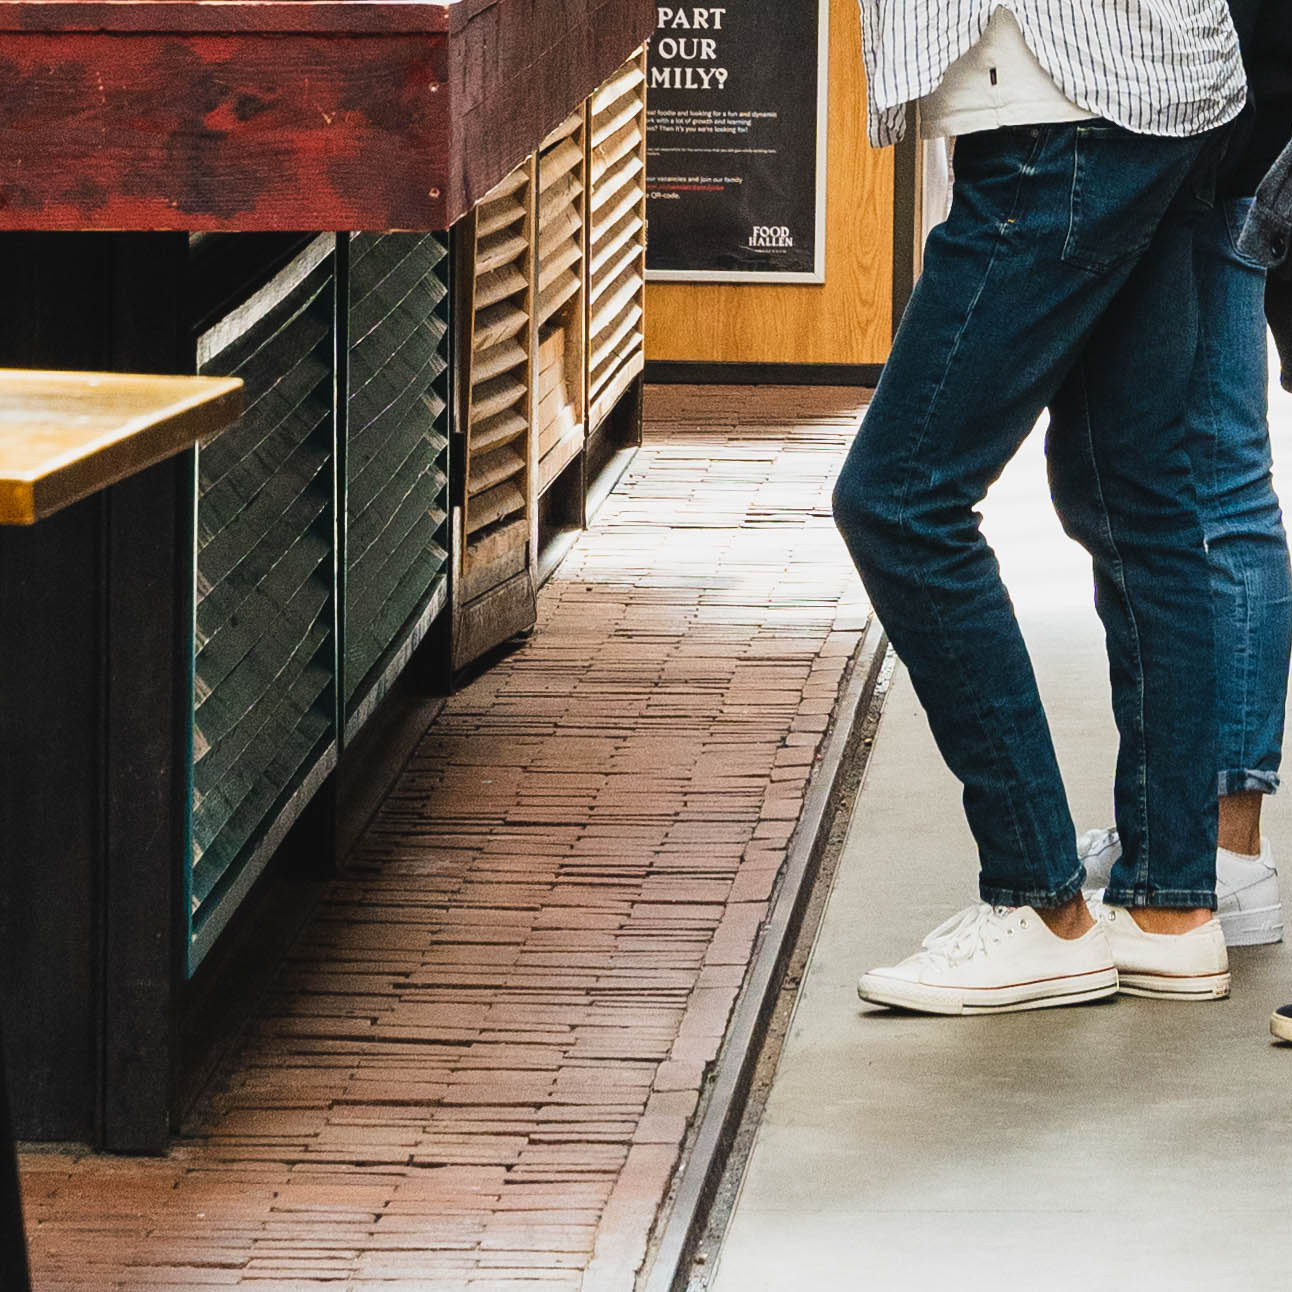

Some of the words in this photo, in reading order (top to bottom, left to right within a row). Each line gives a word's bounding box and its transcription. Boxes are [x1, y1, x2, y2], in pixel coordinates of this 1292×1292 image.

[657, 7, 726, 29] PART
[658, 37, 716, 60] OUR
[647, 66, 728, 89] MILY?
[749, 236, 793, 247] HALLEN
[753, 226, 789, 237] FOOD
